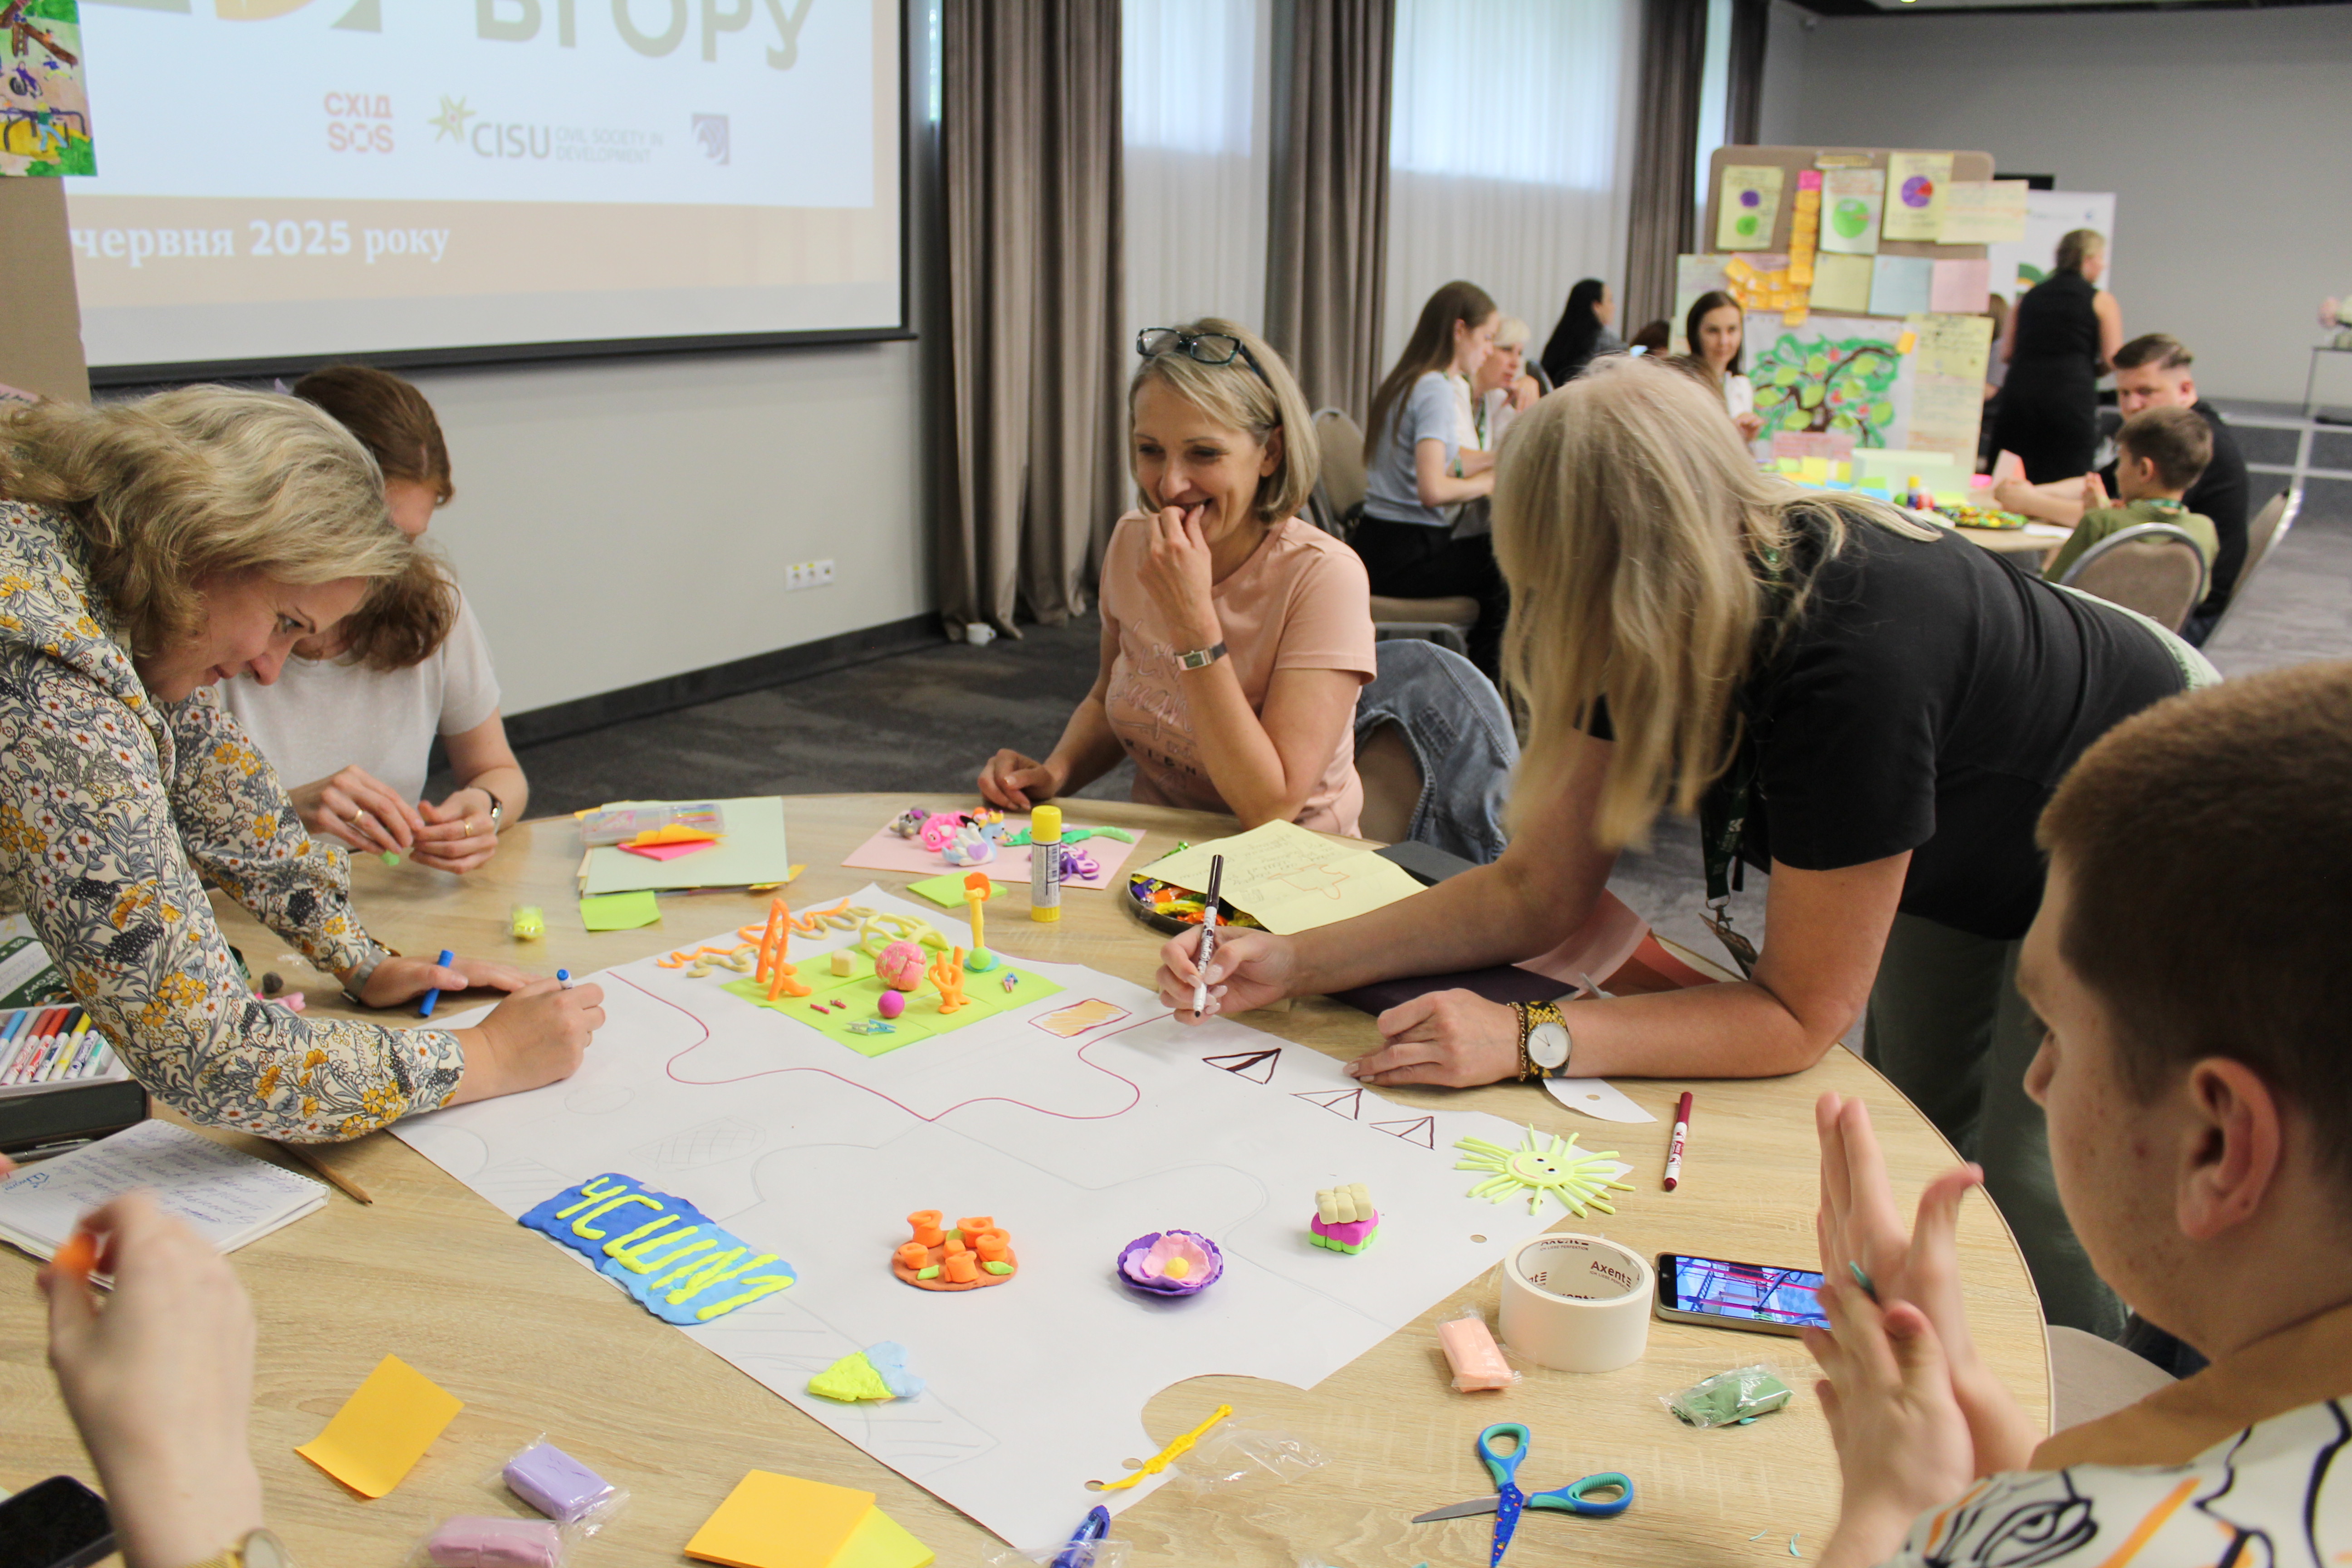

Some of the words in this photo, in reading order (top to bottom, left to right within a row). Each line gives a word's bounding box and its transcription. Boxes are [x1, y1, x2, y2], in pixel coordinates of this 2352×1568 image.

[323, 92, 394, 119] СХІД
[328, 121, 394, 153] SOS
[471, 122, 551, 159] CISU
[555, 126, 586, 144] CIVIL
[593, 127, 645, 146] SOCIETY
[650, 132, 663, 147] IN
[556, 145, 651, 163] DEVELOPMENT
[71, 228, 235, 268] червня
[249, 220, 351, 256] 2025
[364, 226, 450, 265] року
[1590, 1261, 1625, 1283] Axent
